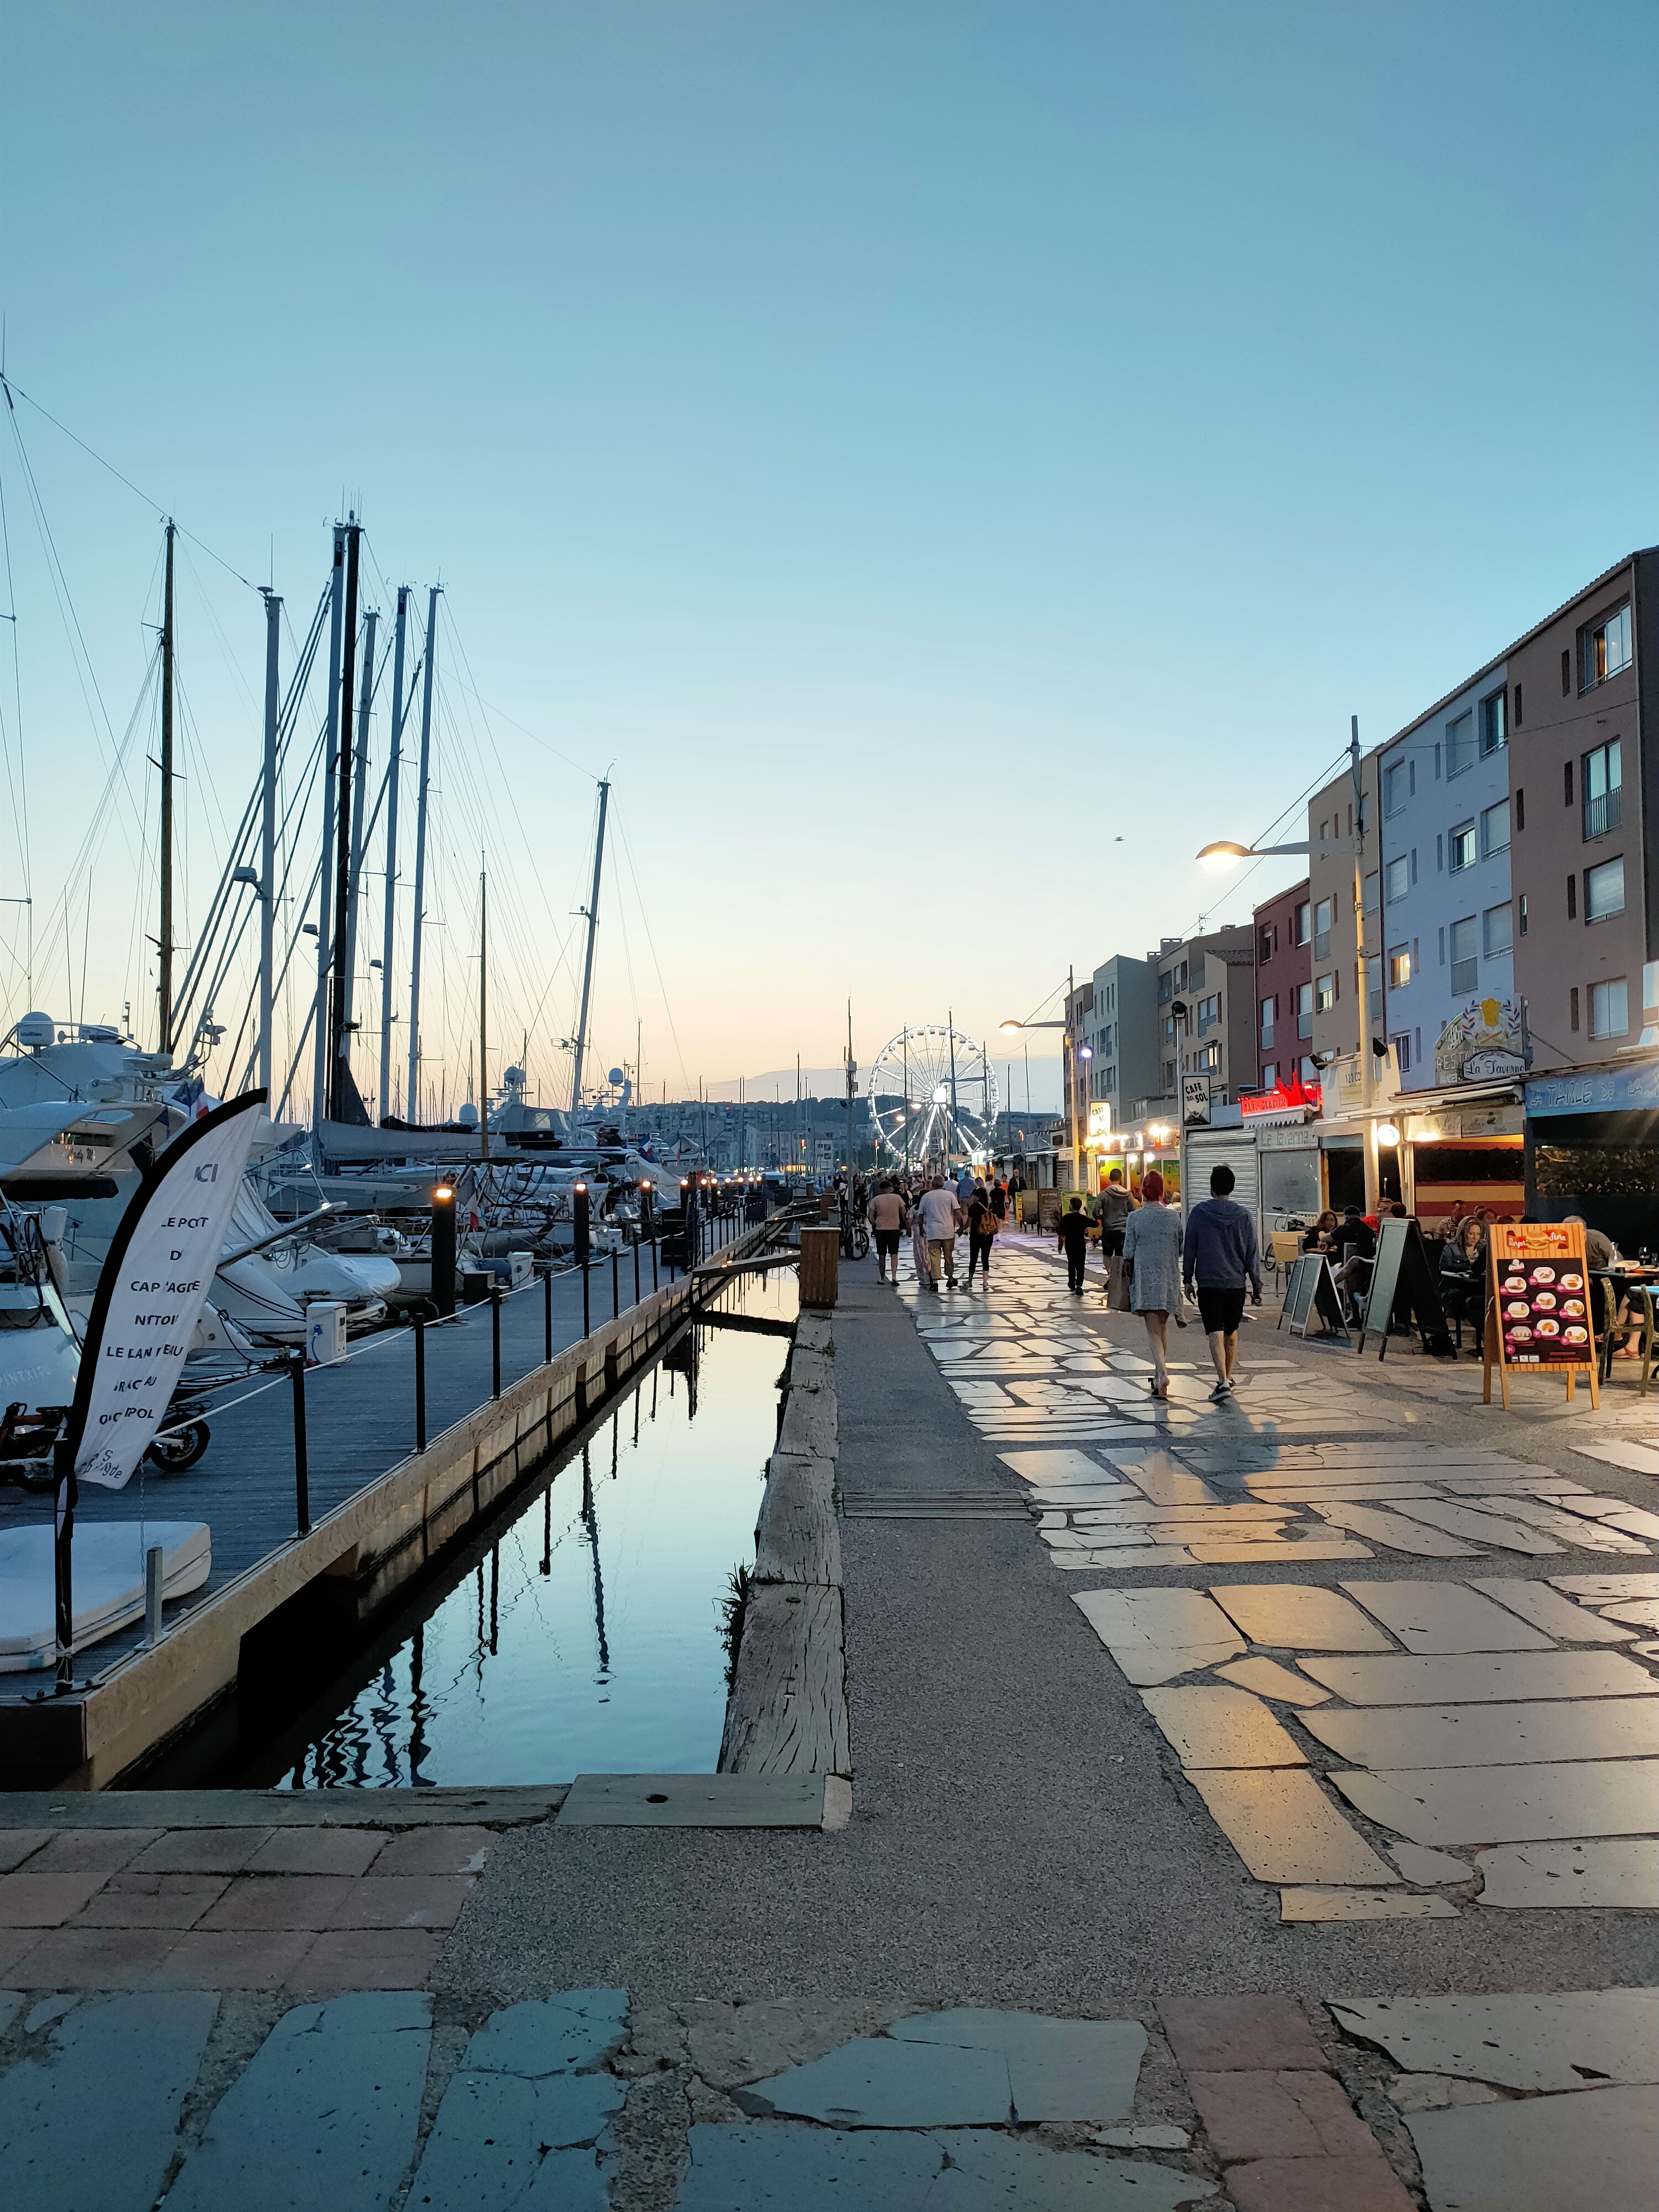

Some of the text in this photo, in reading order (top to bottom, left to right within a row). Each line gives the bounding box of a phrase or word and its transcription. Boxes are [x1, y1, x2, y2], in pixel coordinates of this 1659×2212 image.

[1465, 1060, 1525, 1074] La Taverne
[1195, 1092, 1208, 1103] SOL
[1531, 1089, 1542, 1106] LA
[1548, 1080, 1593, 1106] TABLE
[1601, 1082, 1615, 1100] DE
[1628, 1078, 1642, 1096] LA
[1244, 1103, 1255, 1112] BAR
[1261, 1098, 1286, 1110] GLACIER
[195, 1164, 218, 1182] ICI
[131, 1281, 161, 1292] CAP
[106, 1346, 124, 1358] LE
